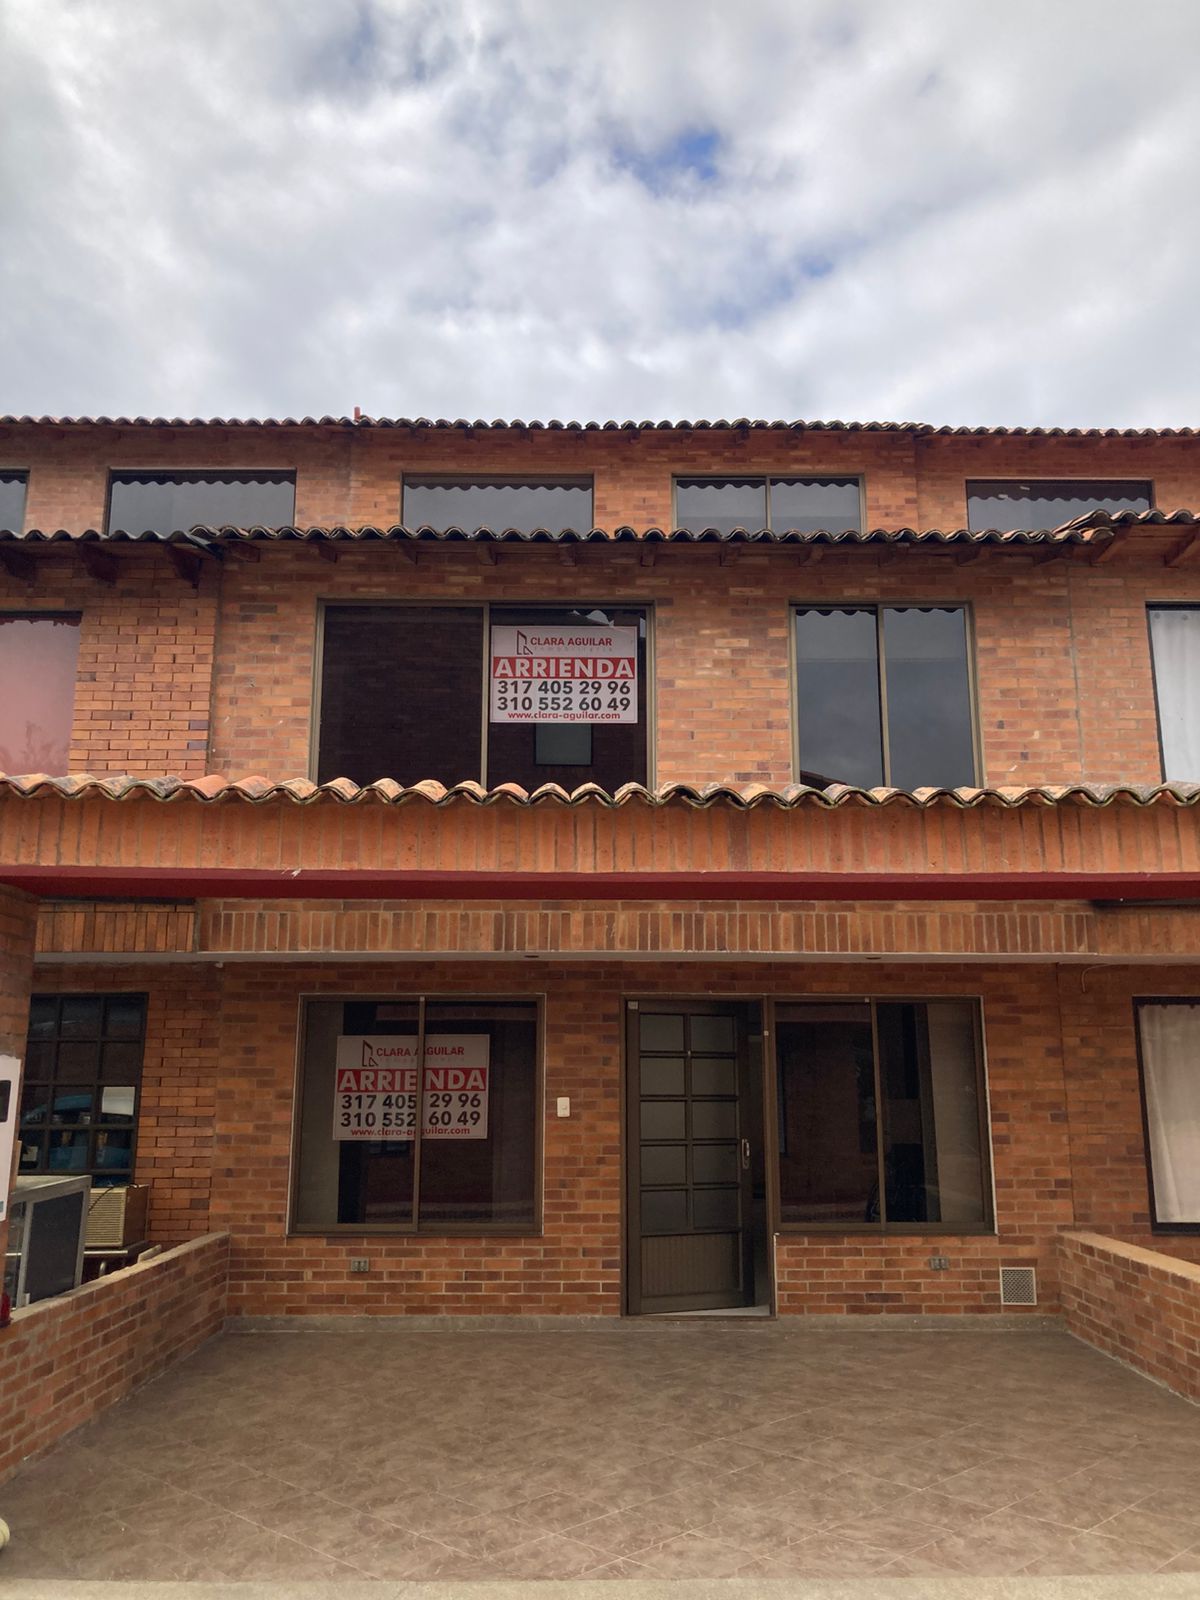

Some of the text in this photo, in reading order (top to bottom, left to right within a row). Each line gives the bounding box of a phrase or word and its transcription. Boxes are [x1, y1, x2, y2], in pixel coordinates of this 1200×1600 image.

[530, 637, 613, 646] CLARA AGUILAR
[494, 658, 634, 678] ARRIENDA
[497, 680, 631, 694] 317 405 29 96
[497, 697, 631, 711] 310 552 60 49
[508, 711, 621, 720] www.clara-aguilar.com
[376, 1047, 411, 1057] CLARA
[338, 1069, 485, 1091] ARRIENDA
[341, 1093, 481, 1109] 317 405 29 96
[340, 1111, 481, 1127] 310 552 60 49
